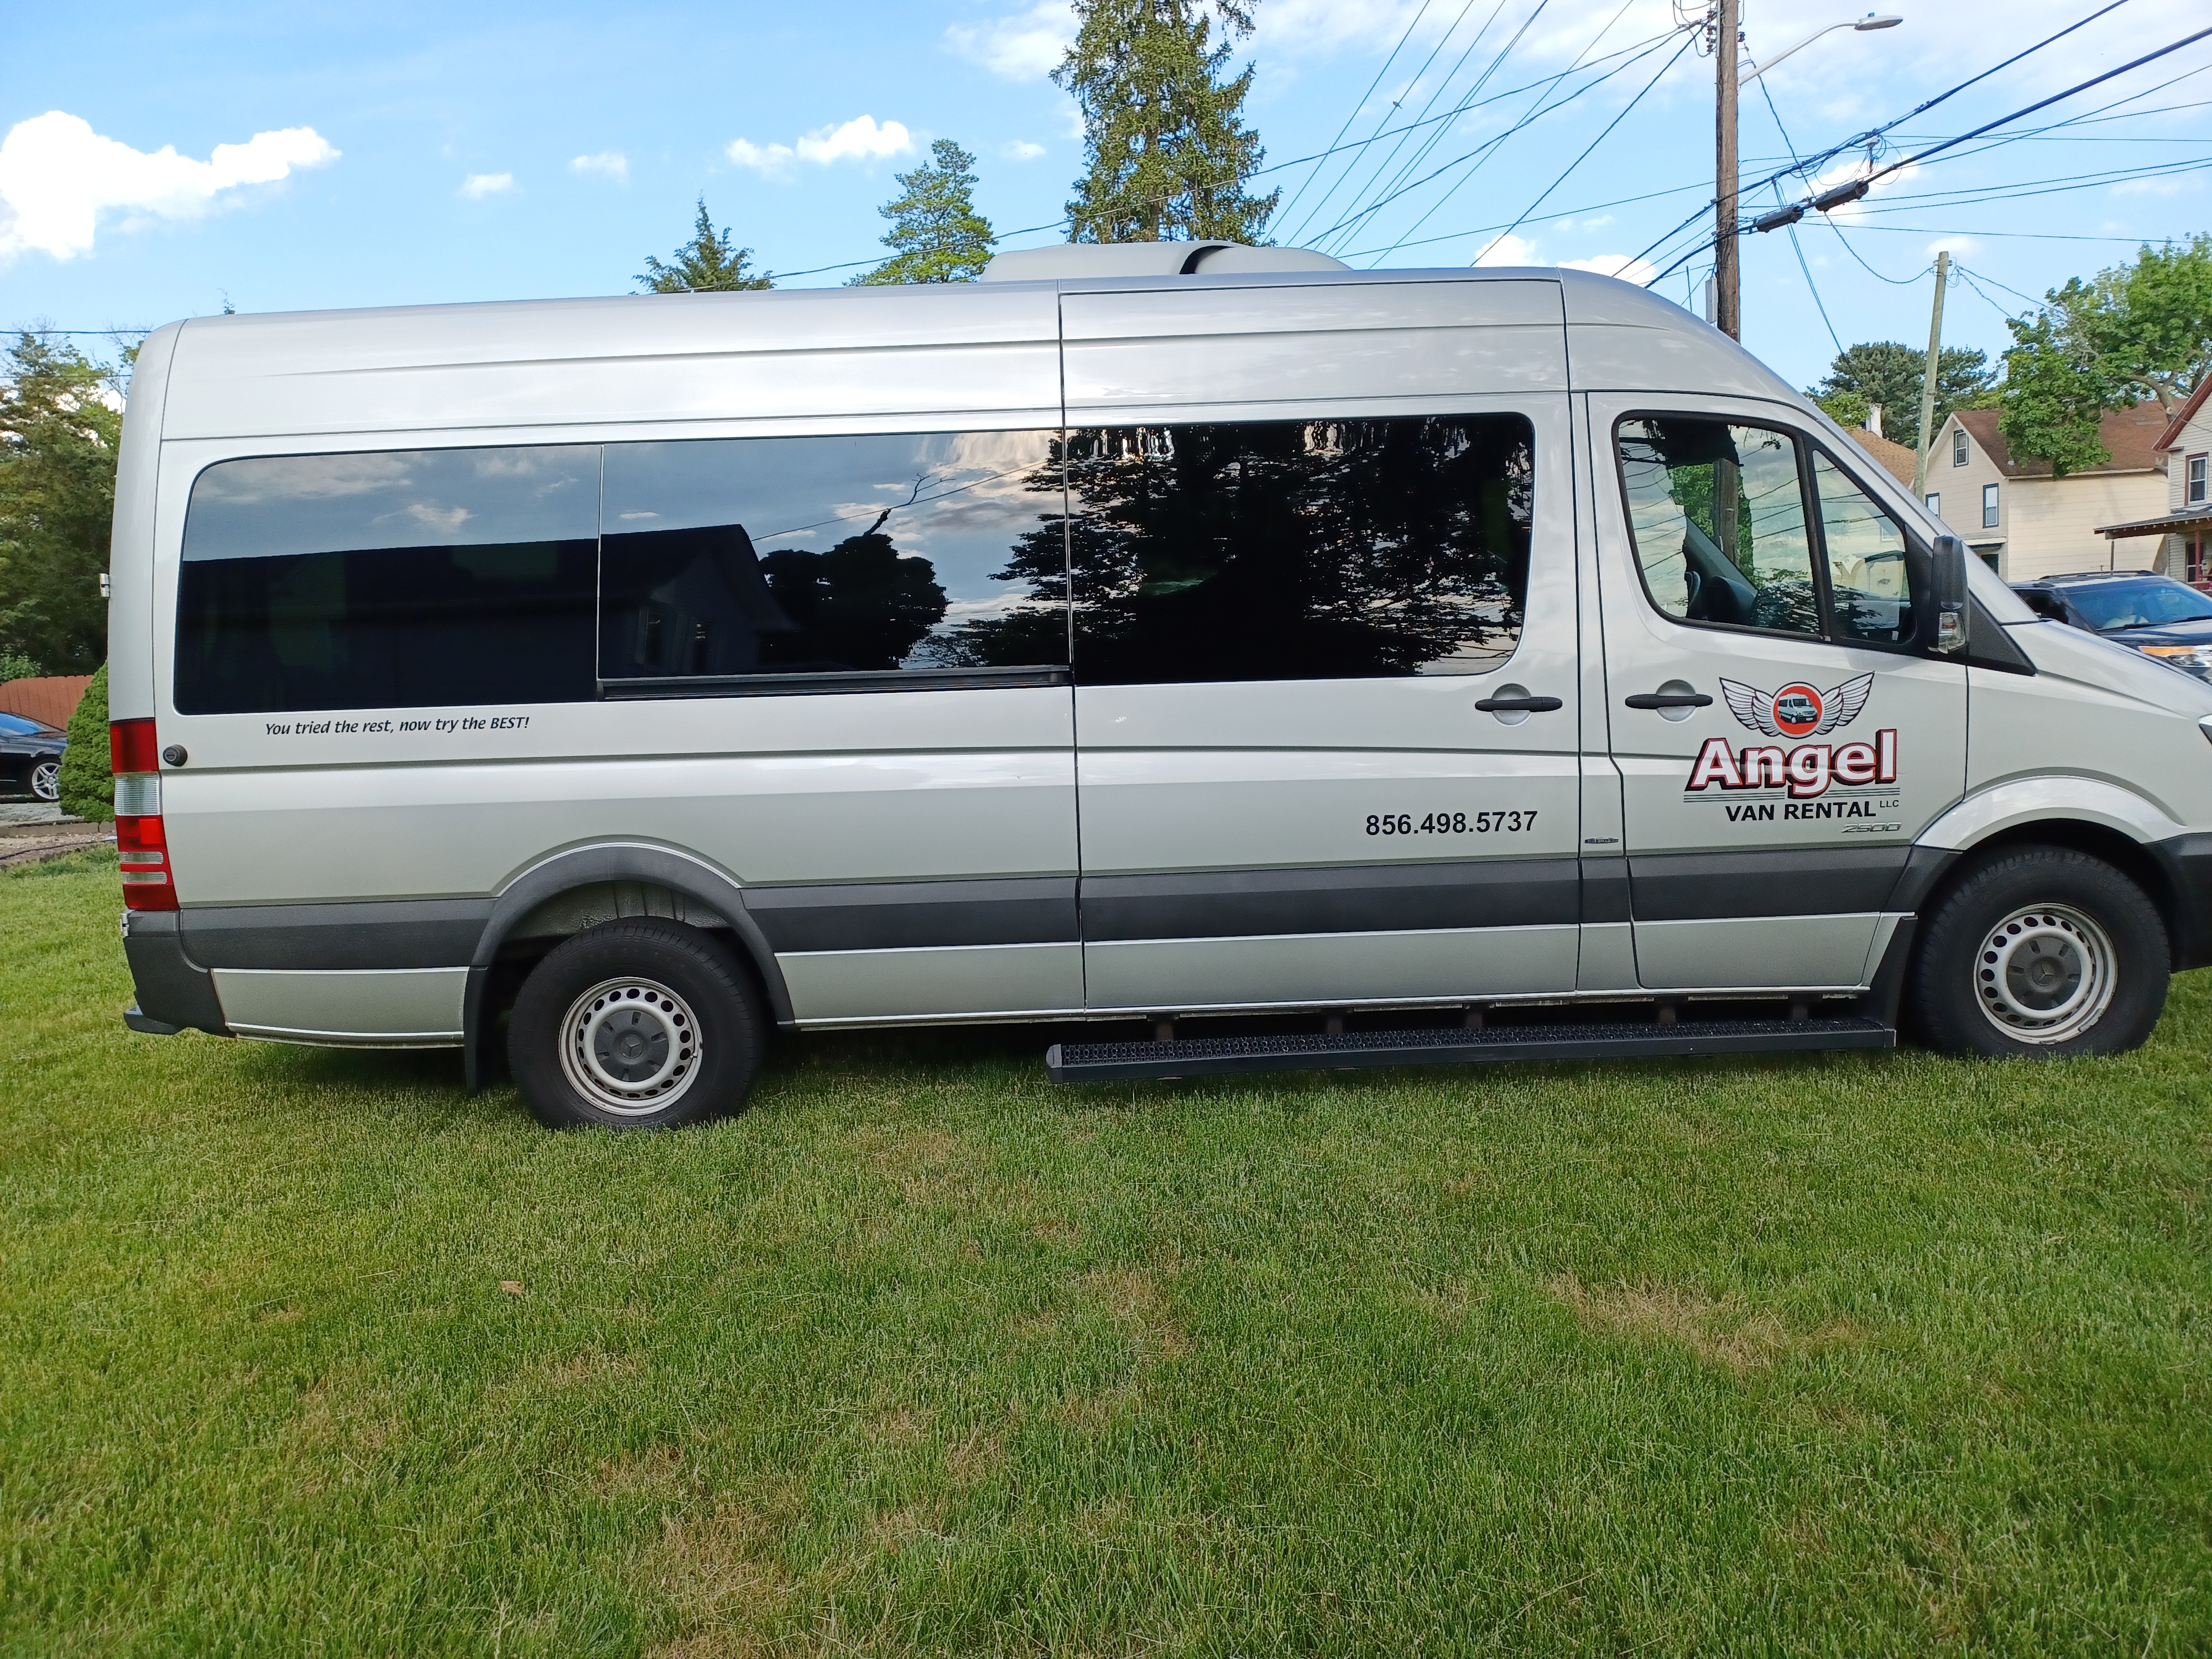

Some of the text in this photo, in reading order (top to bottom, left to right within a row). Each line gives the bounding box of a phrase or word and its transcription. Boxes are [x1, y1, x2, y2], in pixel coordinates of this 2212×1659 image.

[266, 717, 530, 735] You tried the rest, now try the BEST!
[1684, 728, 1897, 799] Angel
[1725, 800, 1899, 822] VAN RENTAL LLC
[1366, 811, 1538, 835] 856.498.5737
[1841, 822, 1902, 833] 2500
